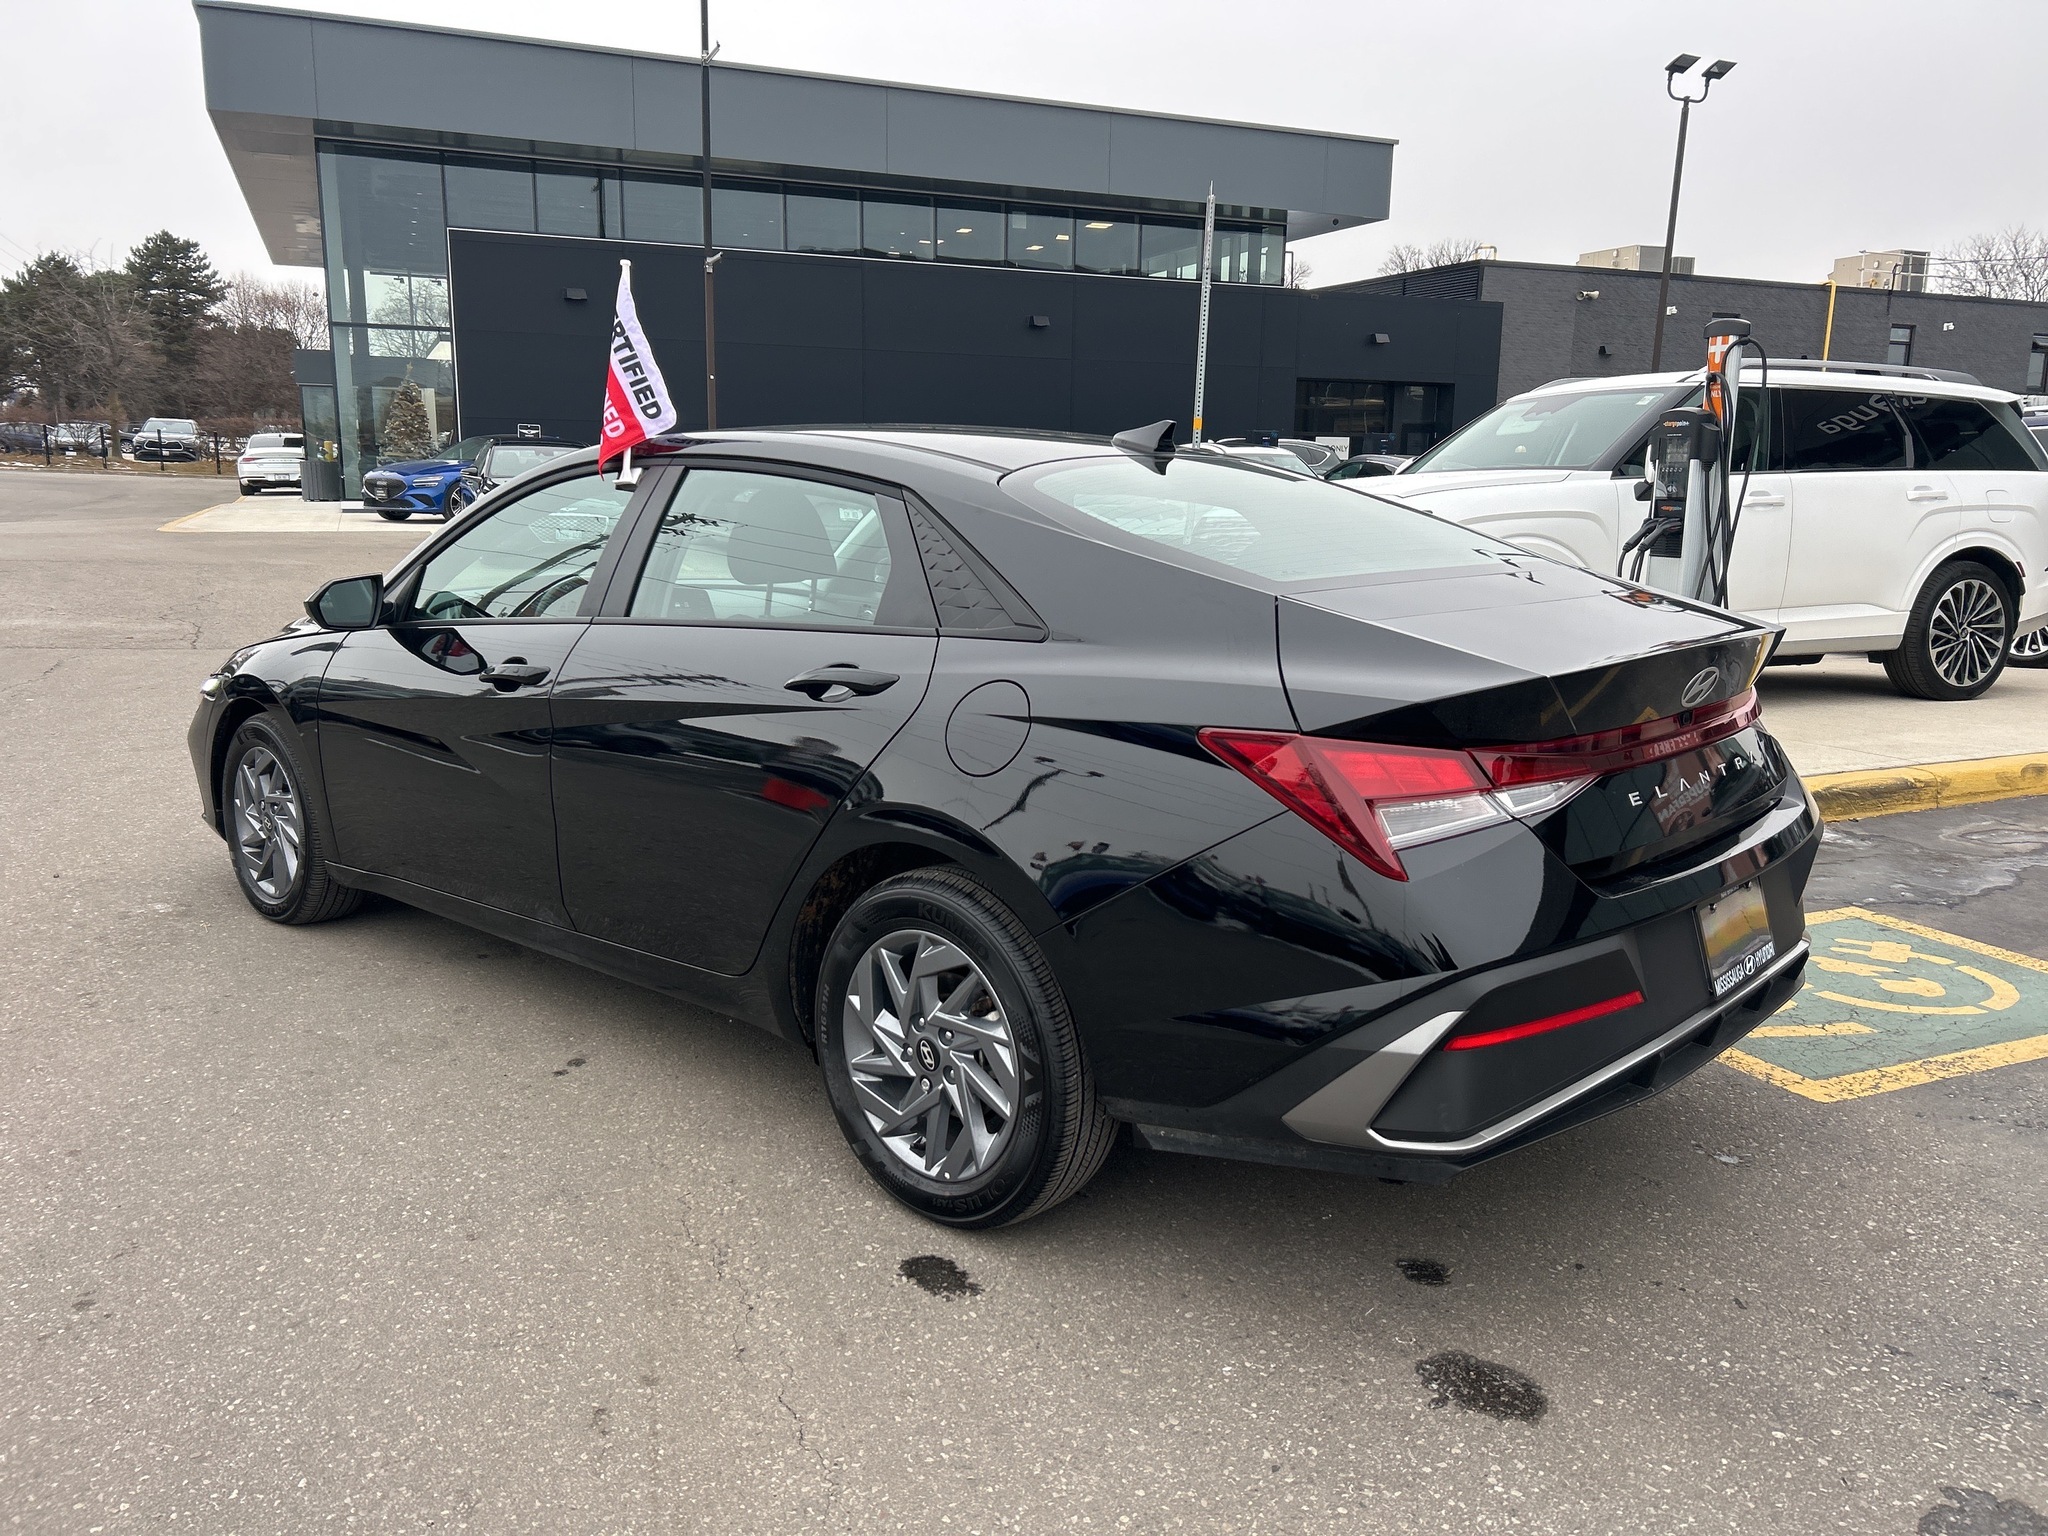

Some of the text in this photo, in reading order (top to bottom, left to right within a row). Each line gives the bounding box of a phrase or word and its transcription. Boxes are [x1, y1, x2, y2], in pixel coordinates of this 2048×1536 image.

[1628, 750, 1757, 807] ELANTRA
[1714, 941, 1776, 997] MISSISSAUGA HYUNDAI
